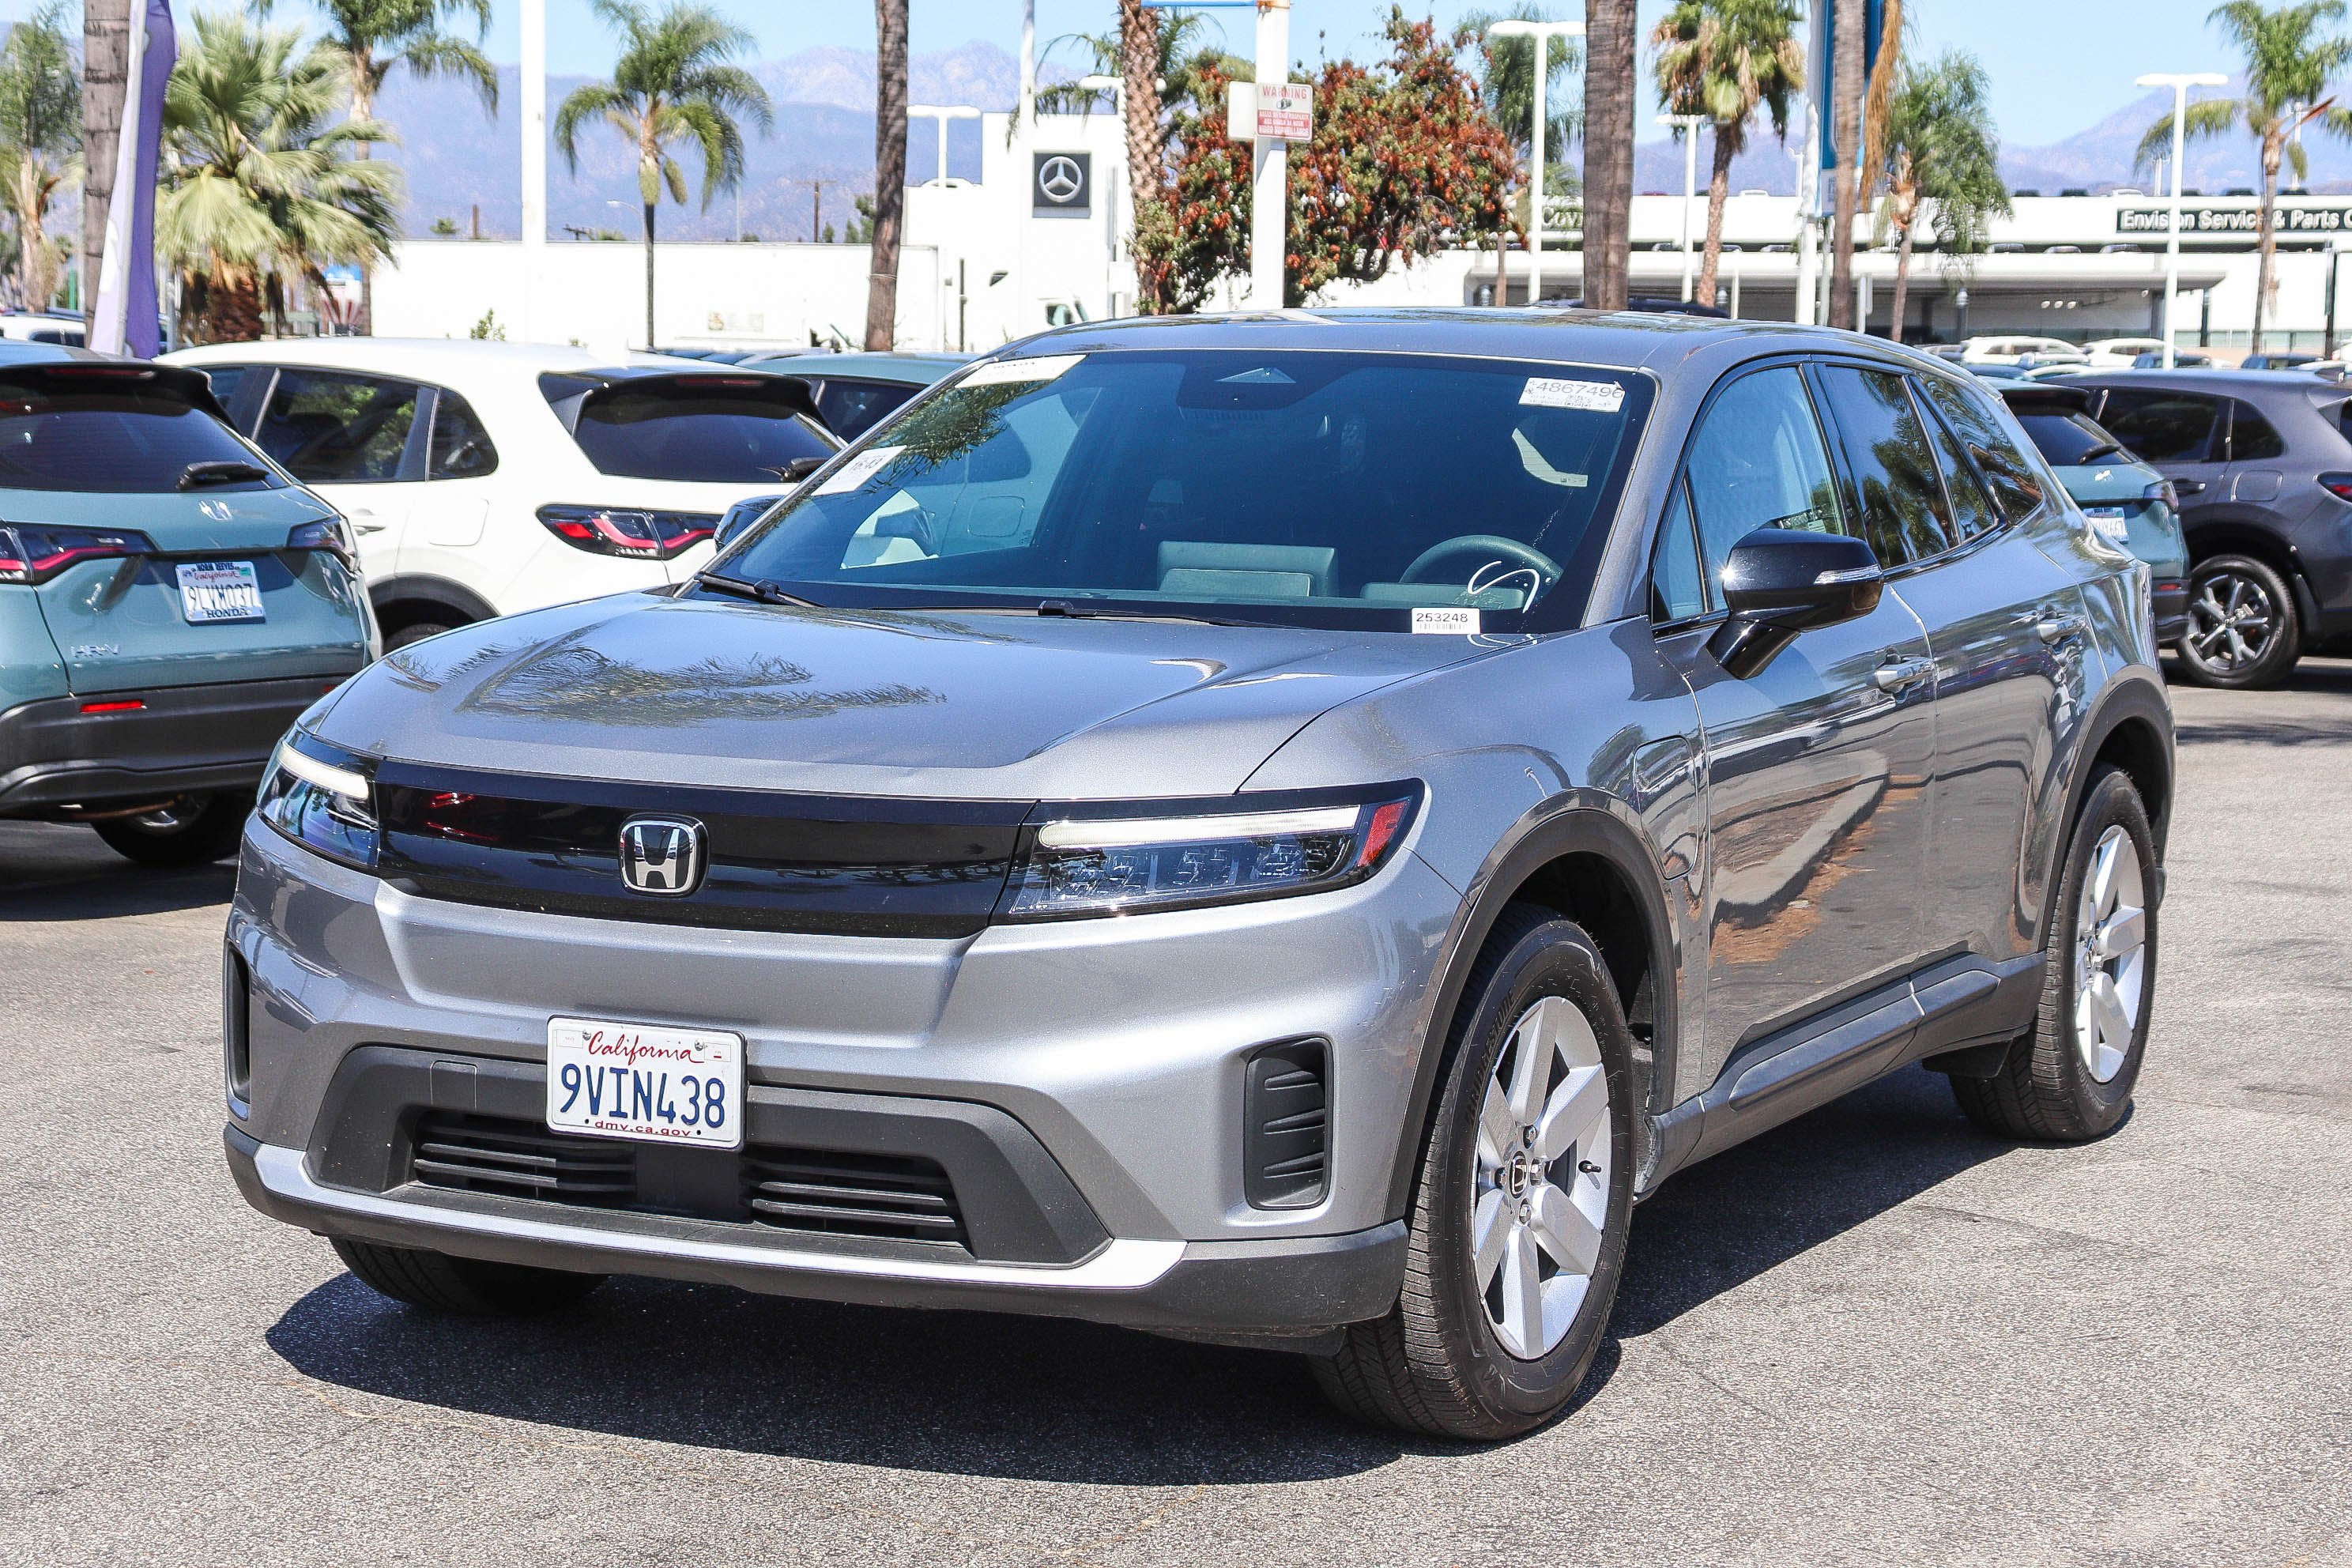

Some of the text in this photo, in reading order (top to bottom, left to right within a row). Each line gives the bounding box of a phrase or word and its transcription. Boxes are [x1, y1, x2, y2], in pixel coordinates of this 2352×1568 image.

[1261, 85, 1307, 99] WARNING
[2120, 209, 2195, 230] Envisn
[2290, 209, 2340, 229] Parts
[1536, 382, 1624, 399] 4867496
[205, 607, 248, 618] HONDA
[1415, 612, 1468, 623] 253248
[588, 1031, 705, 1066] California
[560, 1062, 726, 1129] 9VIN438
[594, 1119, 692, 1136] dmv.ca.gov
